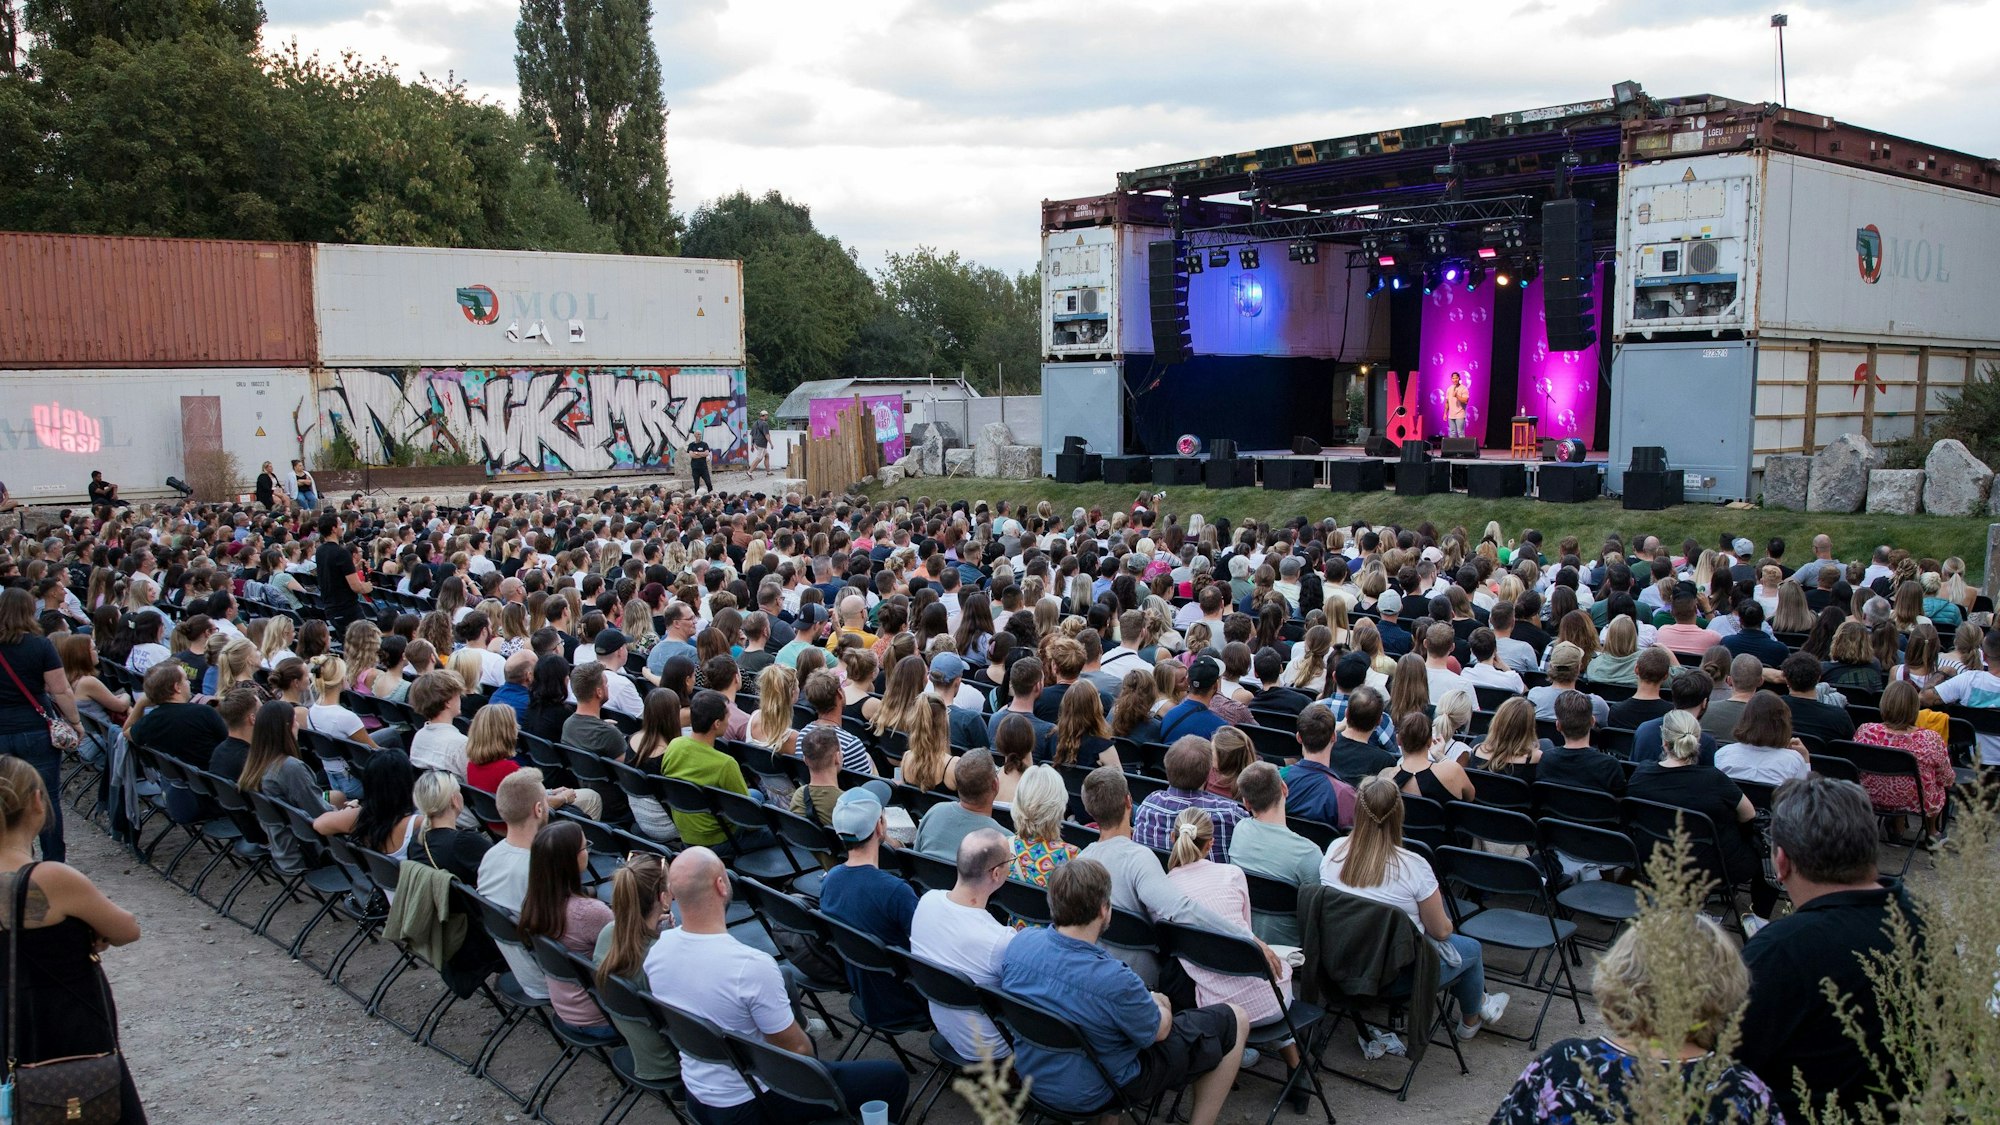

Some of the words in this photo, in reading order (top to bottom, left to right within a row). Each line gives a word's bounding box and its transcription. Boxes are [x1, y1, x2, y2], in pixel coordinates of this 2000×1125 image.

[1708, 128, 1724, 137] LGEU
[1886, 236, 1950, 283] MOL
[509, 291, 609, 321] MOL
[32, 400, 101, 438] night
[35, 426, 101, 453] wash
